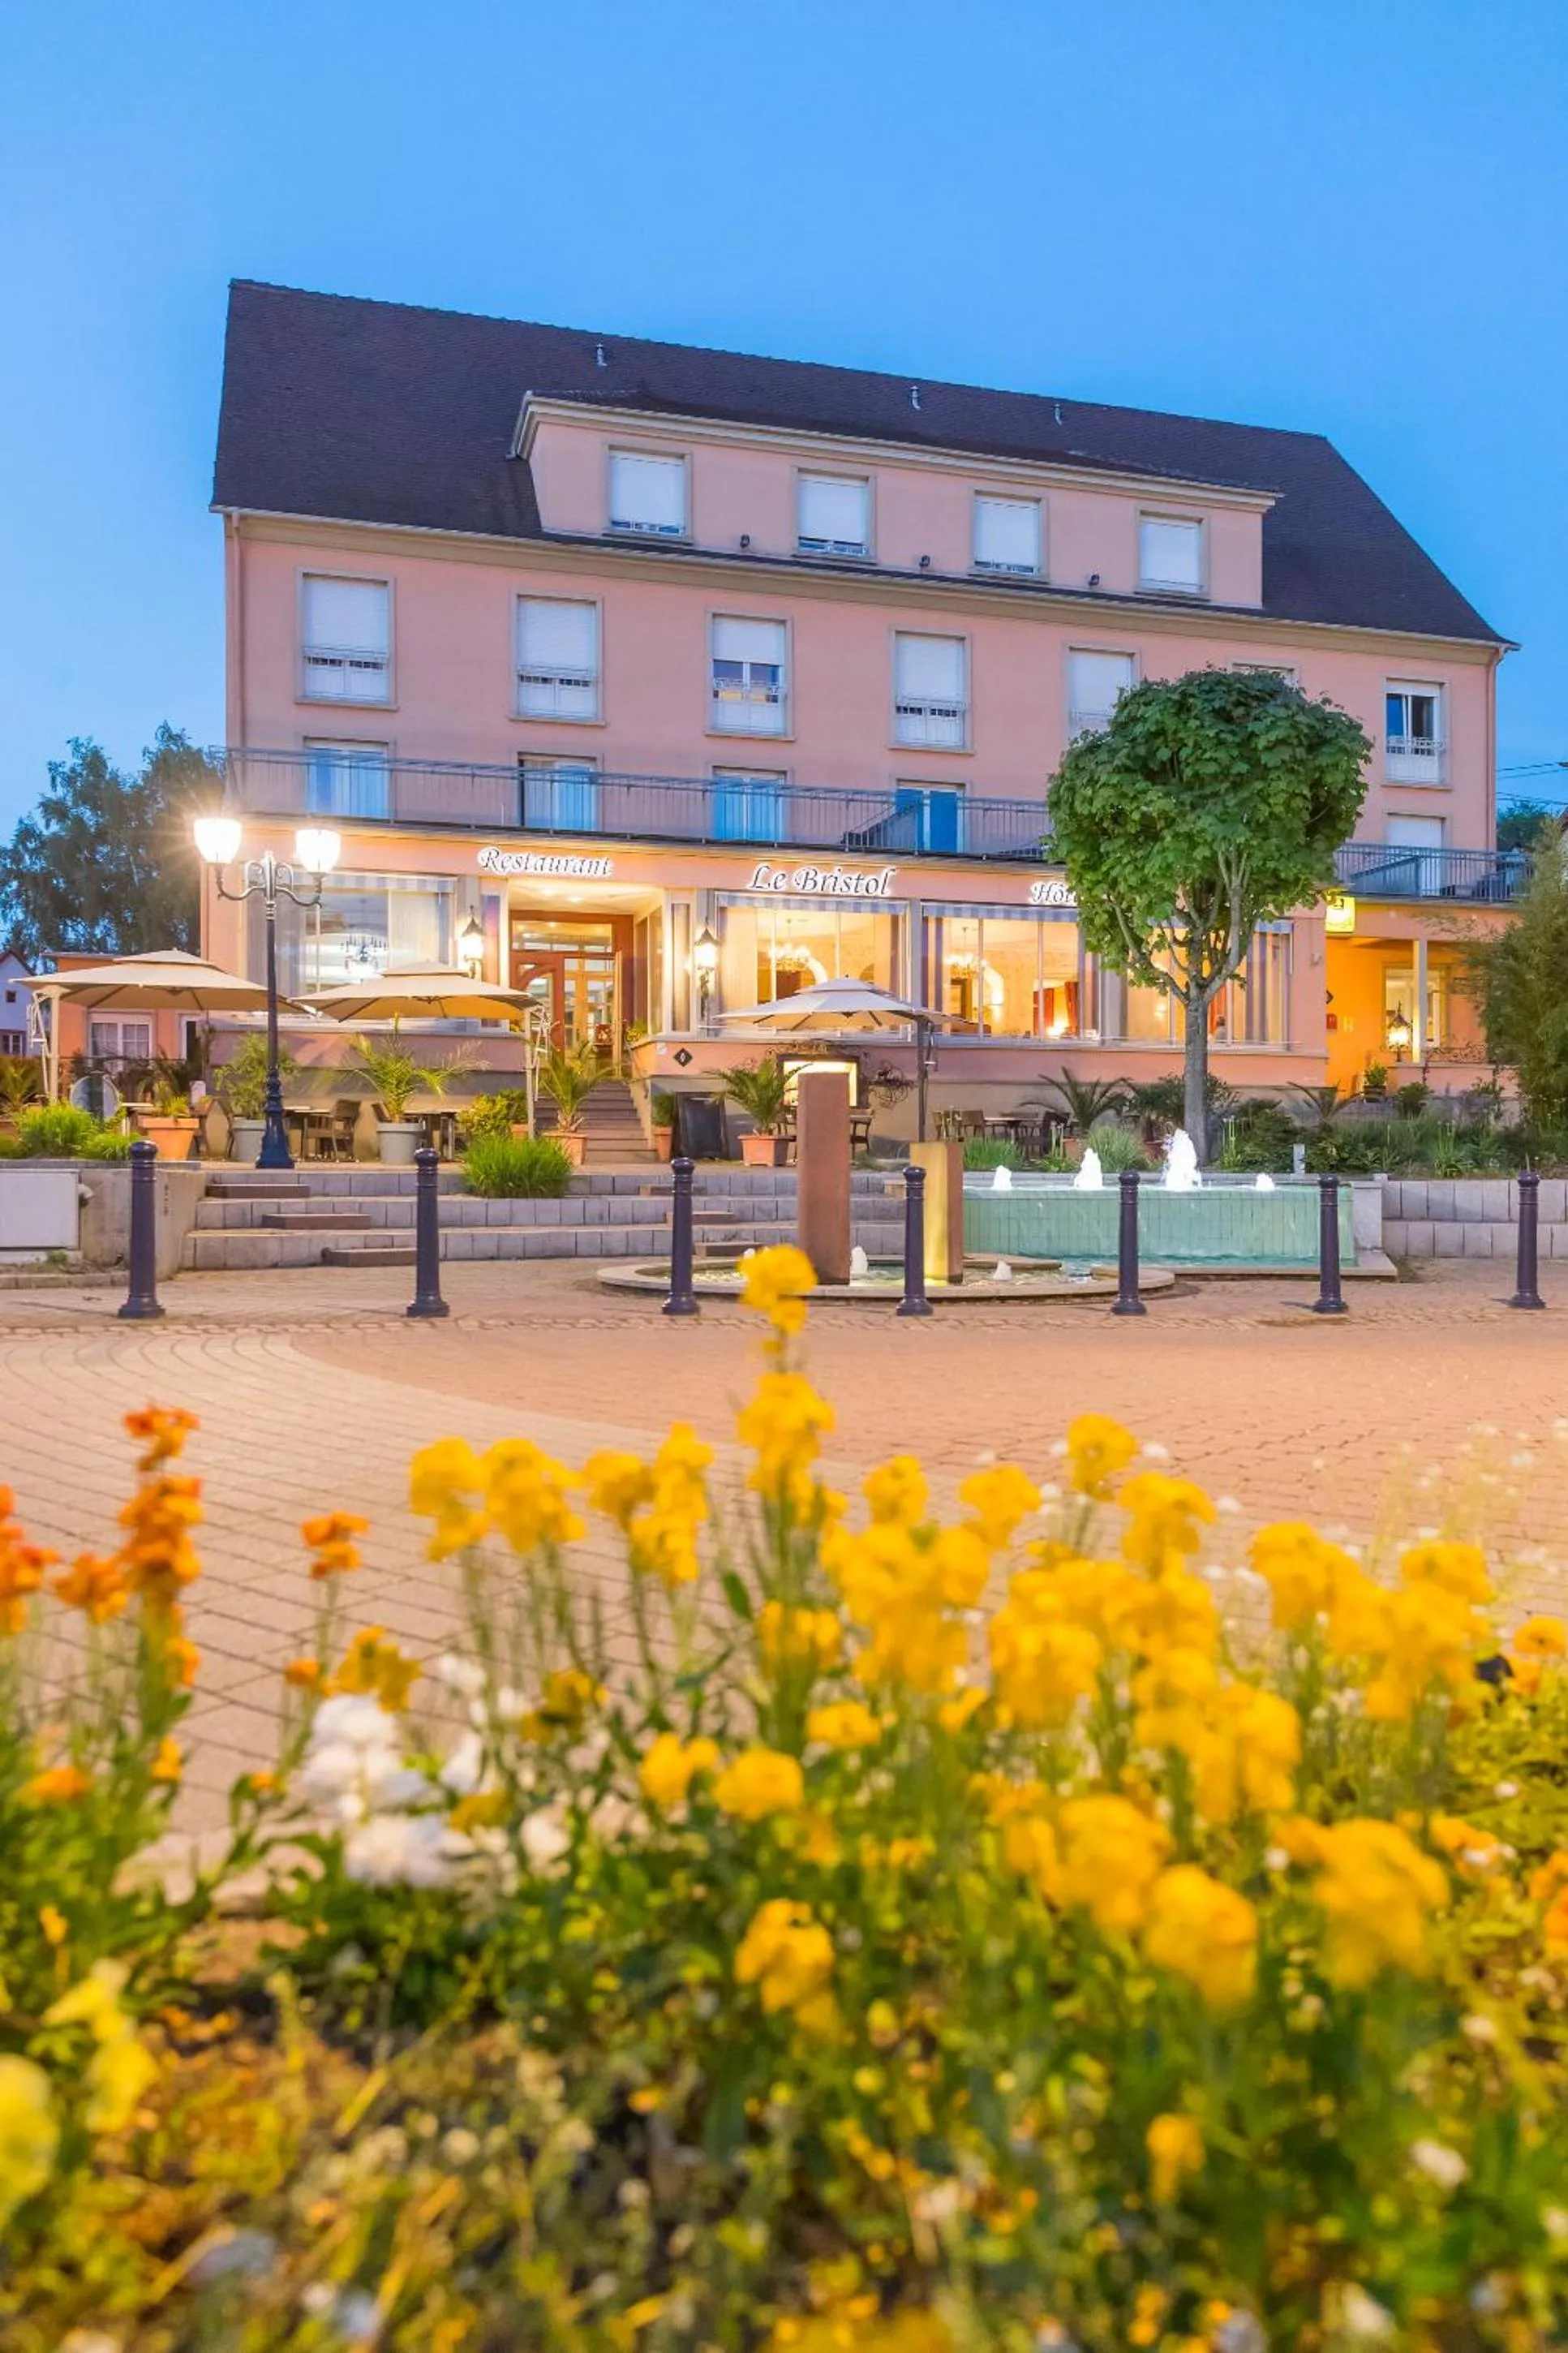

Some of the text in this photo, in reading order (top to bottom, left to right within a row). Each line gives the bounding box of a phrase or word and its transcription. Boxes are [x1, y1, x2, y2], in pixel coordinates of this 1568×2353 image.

[479, 847, 612, 875] Restaurant
[749, 864, 896, 895] Le Bristol
